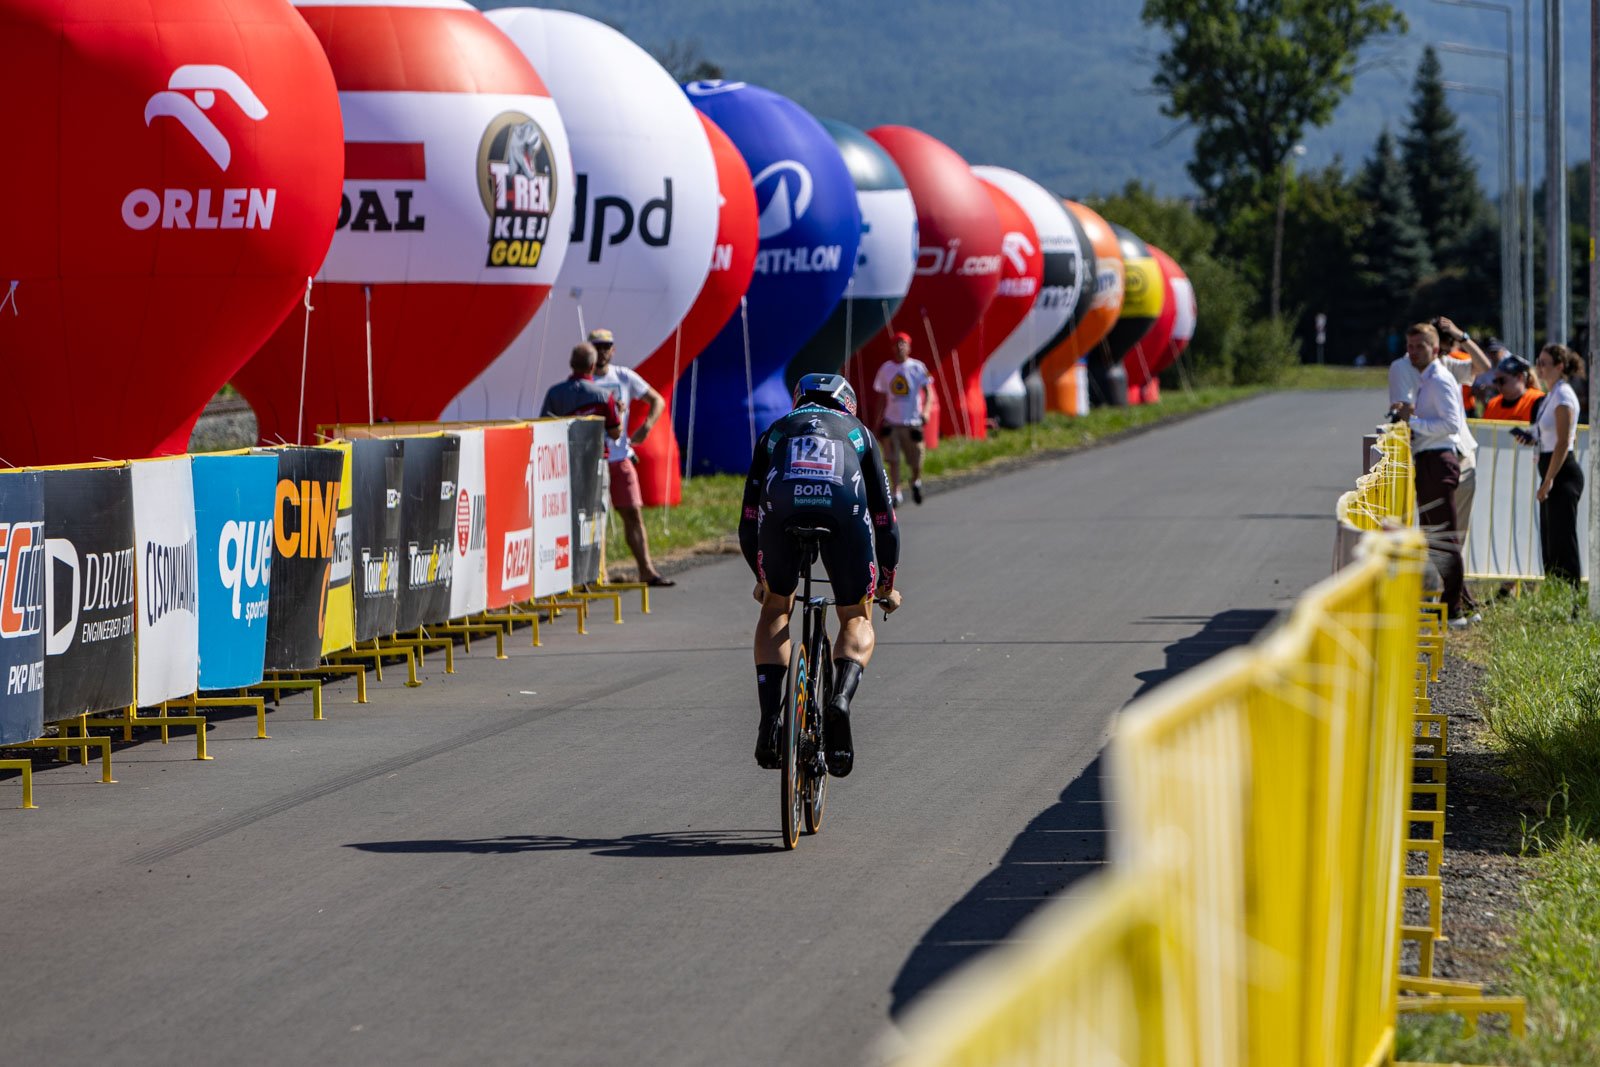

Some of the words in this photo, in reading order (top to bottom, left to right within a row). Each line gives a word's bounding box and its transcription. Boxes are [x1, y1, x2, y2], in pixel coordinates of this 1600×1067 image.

[490, 162, 550, 213] T-REX
[122, 188, 276, 230] ORLEN
[494, 216, 547, 239] KLEJ
[490, 240, 542, 267] GOLD
[794, 438, 834, 463] 124
[794, 484, 833, 496] BORA
[794, 497, 831, 505] hansgrohe
[409, 545, 430, 586] Tour
[505, 535, 531, 582] ORLEN
[82, 619, 121, 643] ENGINEERED
[7, 665, 28, 695] PKP
